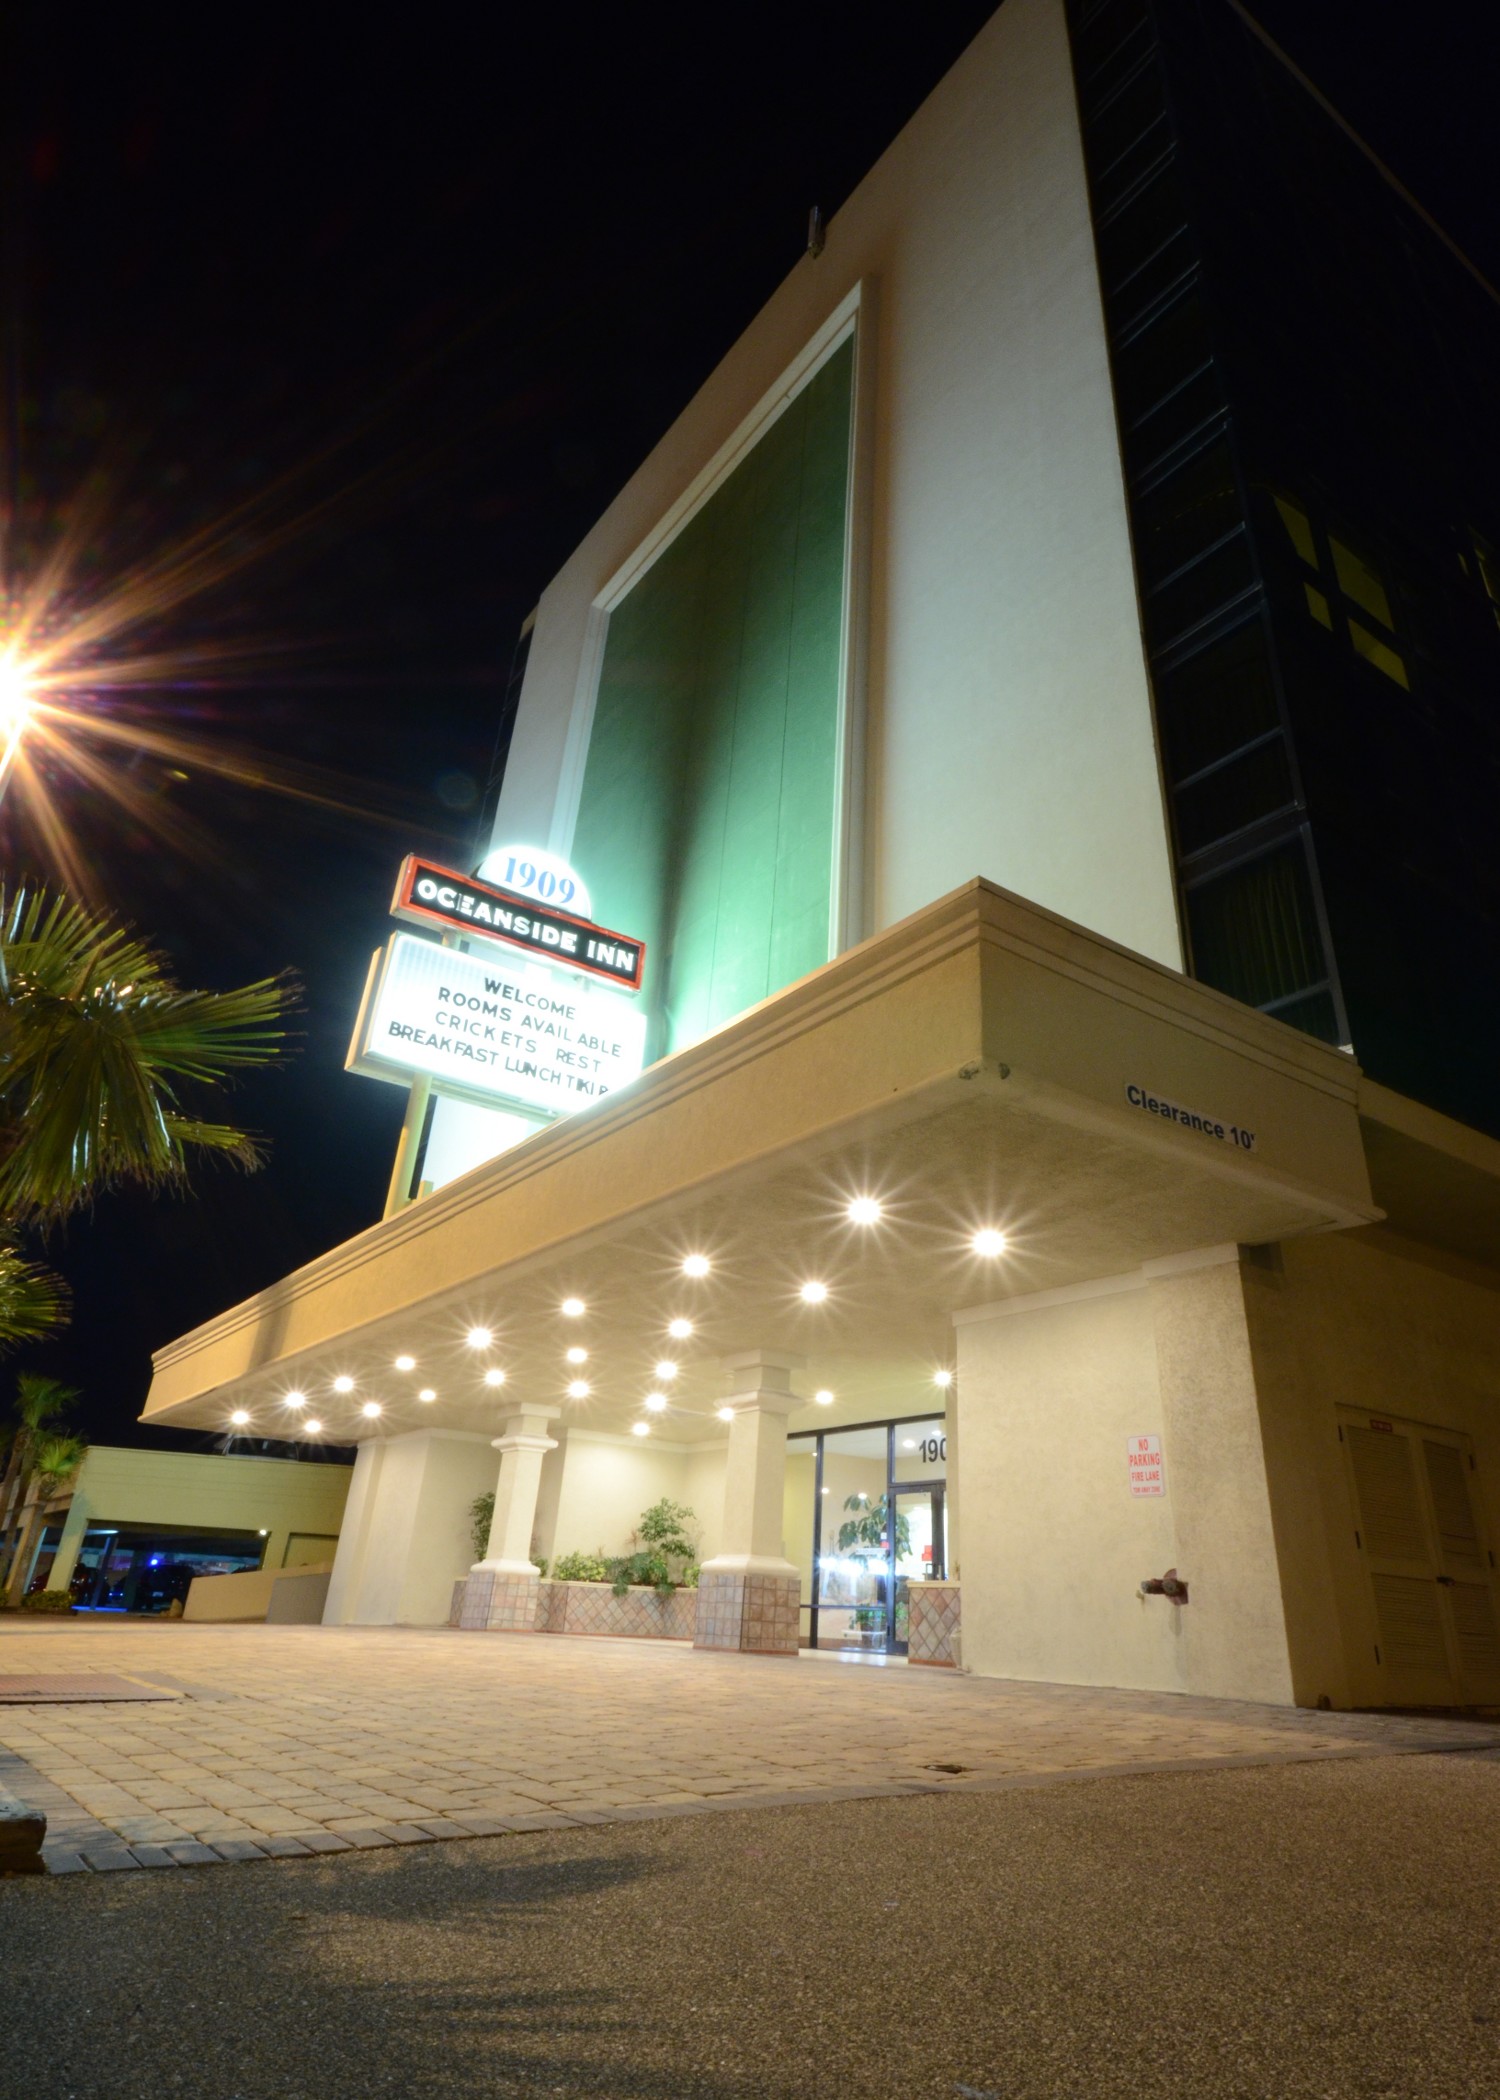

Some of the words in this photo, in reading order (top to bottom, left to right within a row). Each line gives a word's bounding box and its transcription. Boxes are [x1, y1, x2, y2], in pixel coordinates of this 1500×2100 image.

[505, 857, 576, 904] 1909
[417, 879, 577, 953] OCEANSIDE
[587, 940, 635, 972] INN
[438, 986, 512, 1022] ROOMS
[521, 1015, 622, 1058] AVAILABLE
[484, 977, 576, 1020] WELCOME
[388, 1020, 499, 1066] BREAKFAST
[505, 1056, 561, 1084] LUNCH
[435, 1011, 537, 1054] CRICKETS
[556, 1048, 602, 1073] REST
[1127, 1085, 1224, 1139] Clearance
[1129, 1453, 1160, 1466] PARKING
[1138, 1439, 1148, 1451] NO
[1132, 1472, 1144, 1482] FIRE
[1145, 1470, 1160, 1481] LANE
